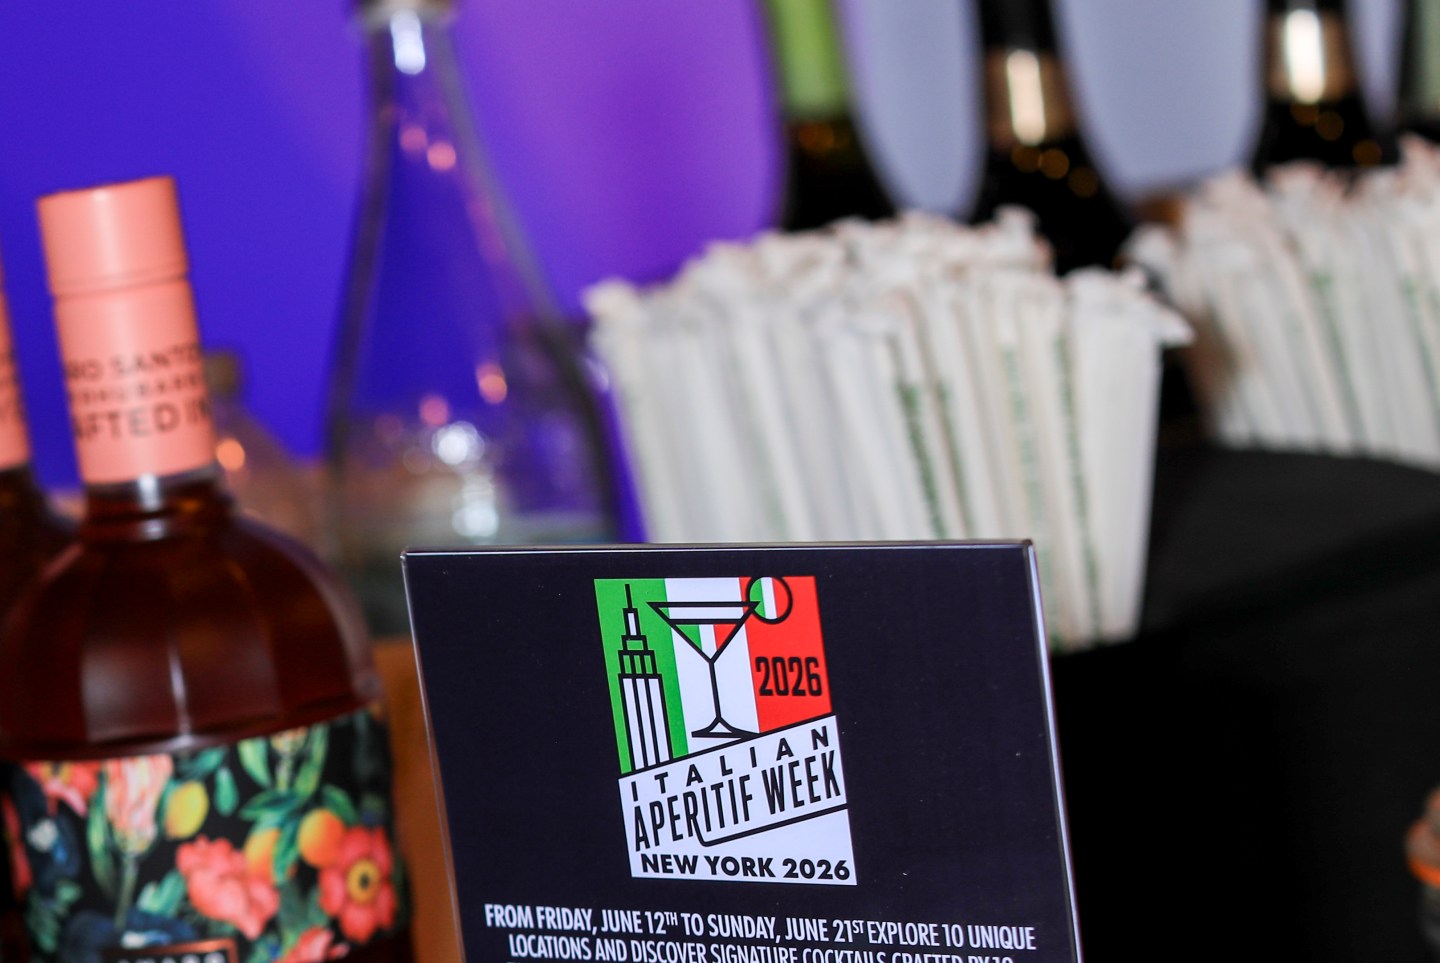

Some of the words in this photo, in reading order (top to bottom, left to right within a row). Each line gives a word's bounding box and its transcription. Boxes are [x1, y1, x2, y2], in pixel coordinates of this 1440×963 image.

[755, 656, 822, 697] 2026
[631, 725, 829, 802] ITALIAN
[634, 774, 753, 852] APERITIF
[761, 750, 841, 815] WEEK
[641, 853, 698, 875] NEW
[704, 855, 776, 878] YORK
[782, 858, 851, 881] 2026
[484, 903, 534, 929] FROM
[536, 906, 597, 935] FRIDAY,
[600, 909, 643, 934] JUNE
[645, 911, 678, 935] 12TH
[681, 912, 704, 937] TO
[707, 914, 781, 943] SUNDAY,
[784, 917, 829, 942] JUNE
[832, 919, 864, 943] 21ST
[867, 921, 940, 947] EXPLORE
[942, 923, 961, 948] 10
[967, 924, 1037, 950] UNIQUE
[509, 933, 592, 961] LOCATIONS
[595, 938, 627, 963] AND
